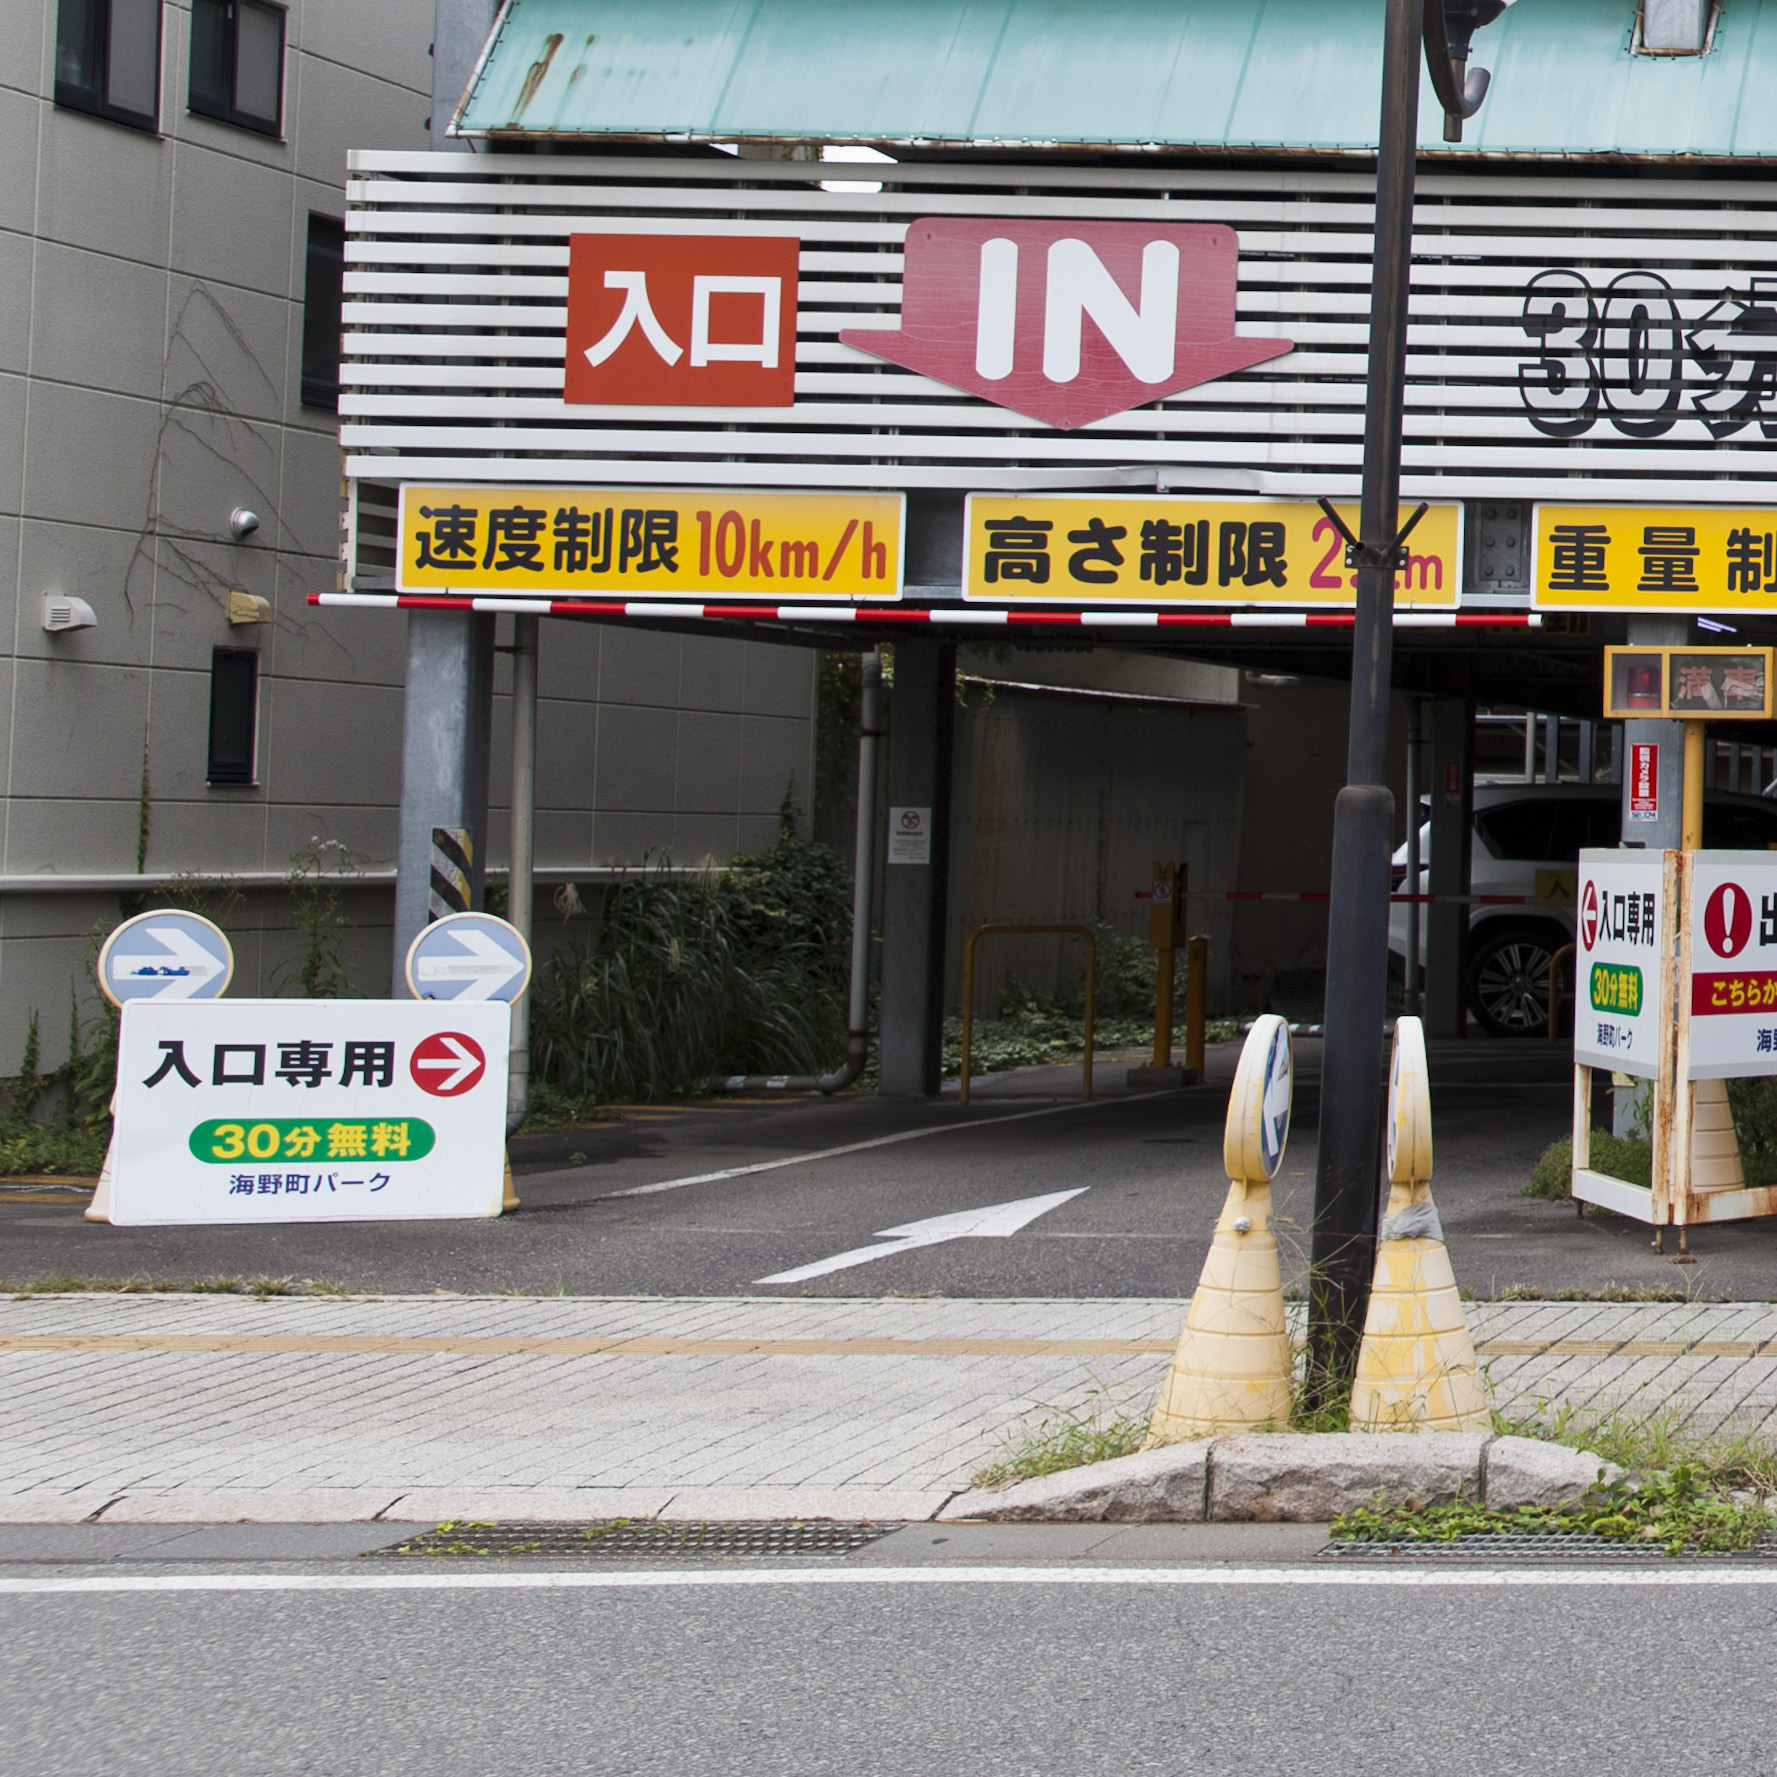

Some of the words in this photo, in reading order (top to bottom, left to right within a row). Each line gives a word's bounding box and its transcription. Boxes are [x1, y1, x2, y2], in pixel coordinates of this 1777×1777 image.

[584, 269, 783, 370] 入口
[976, 236, 1180, 384] IN
[982, 515, 1443, 591] 高さ制限2.m
[1599, 890, 1656, 948] 入口専用
[1593, 968, 1640, 1011] 30分無料
[1595, 1021, 1634, 1051] 海野町パーク
[142, 1039, 396, 1089] 入口専用
[211, 1122, 412, 1159] 30分無料
[228, 1171, 392, 1197] 海野町パーク
